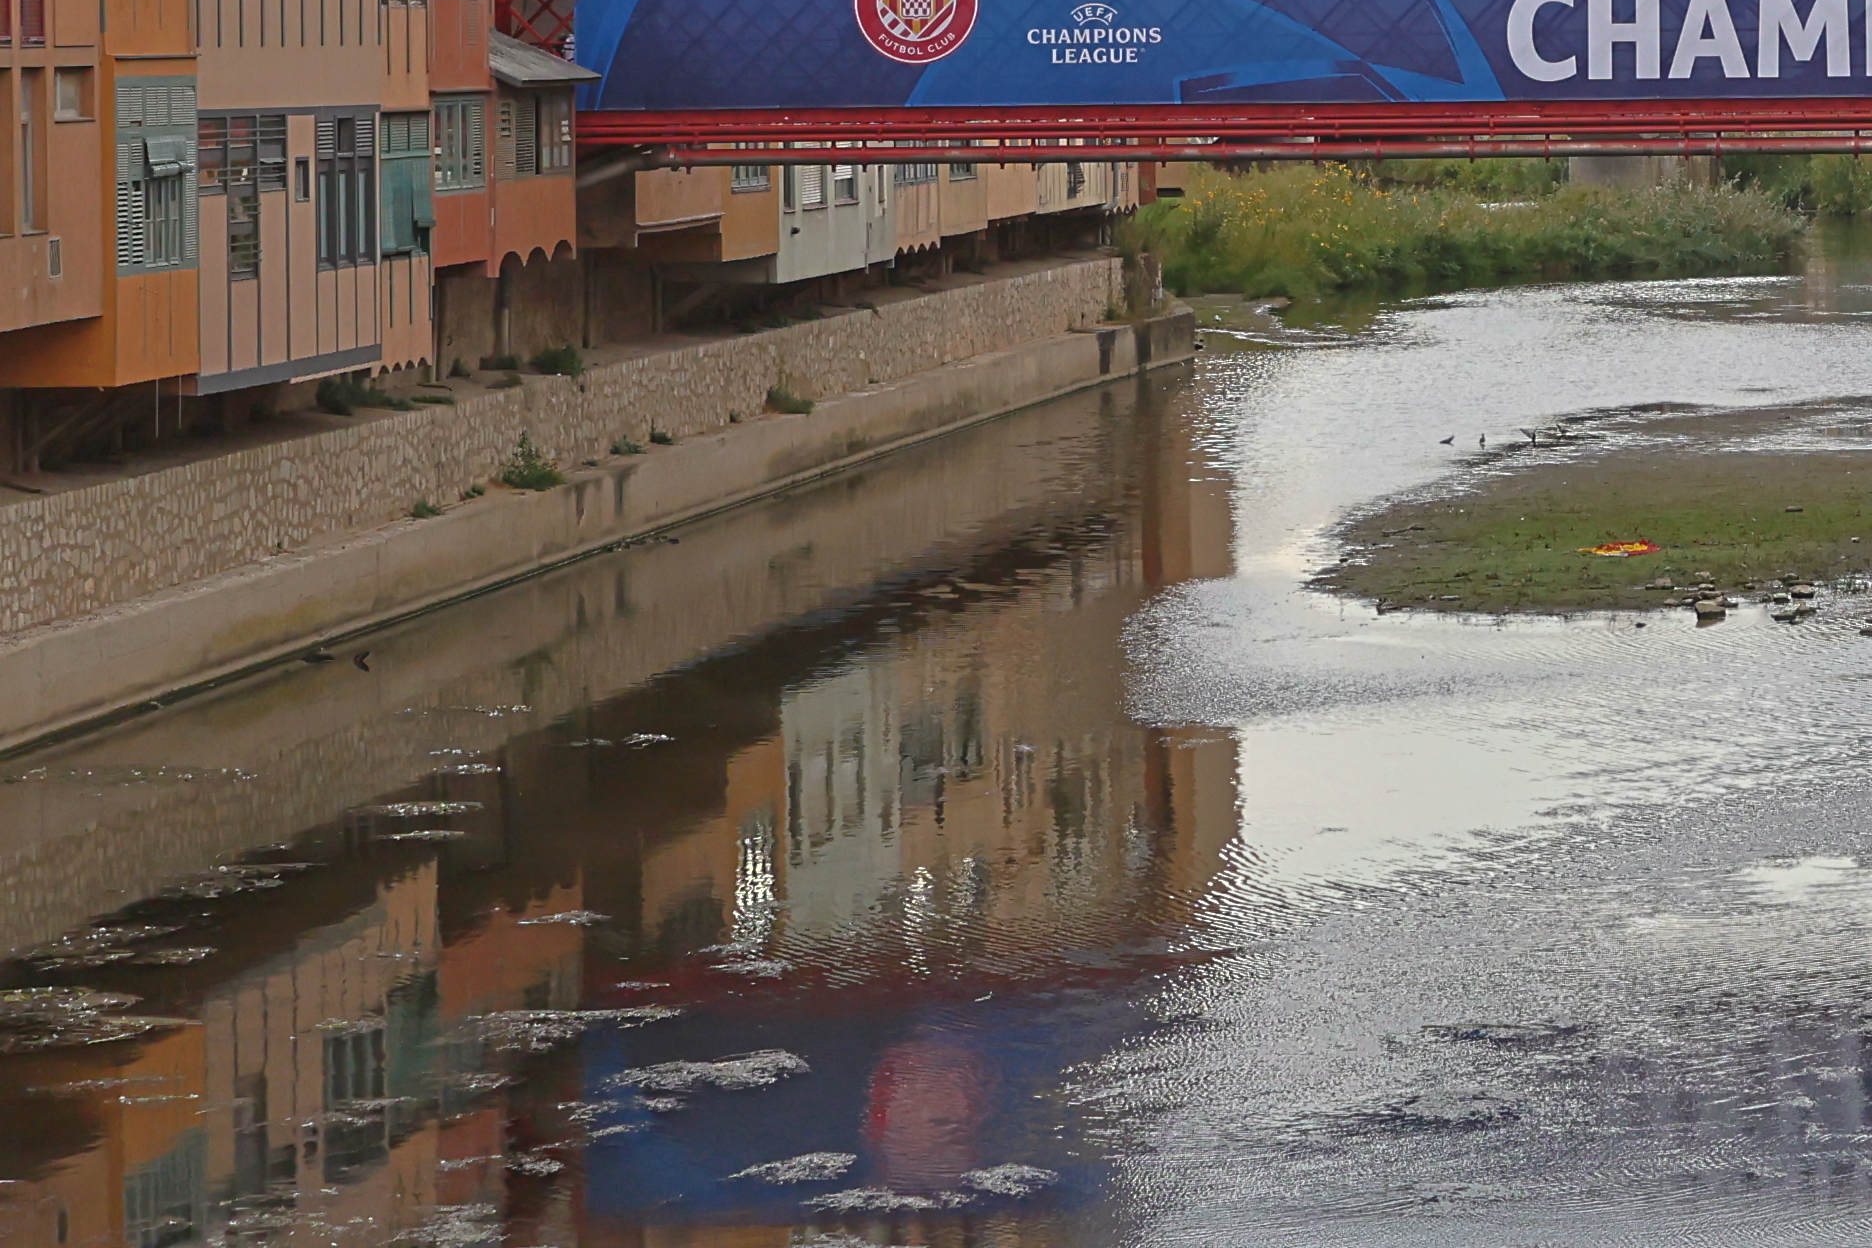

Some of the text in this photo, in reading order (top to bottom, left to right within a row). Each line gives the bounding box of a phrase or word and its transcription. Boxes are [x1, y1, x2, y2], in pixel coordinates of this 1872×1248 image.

[1072, 6, 1114, 23] UEFA
[878, 32, 956, 55] FUTBOL CLUB
[1027, 27, 1162, 45] CHAMPIONS
[1051, 47, 1139, 64] LEAGUE
